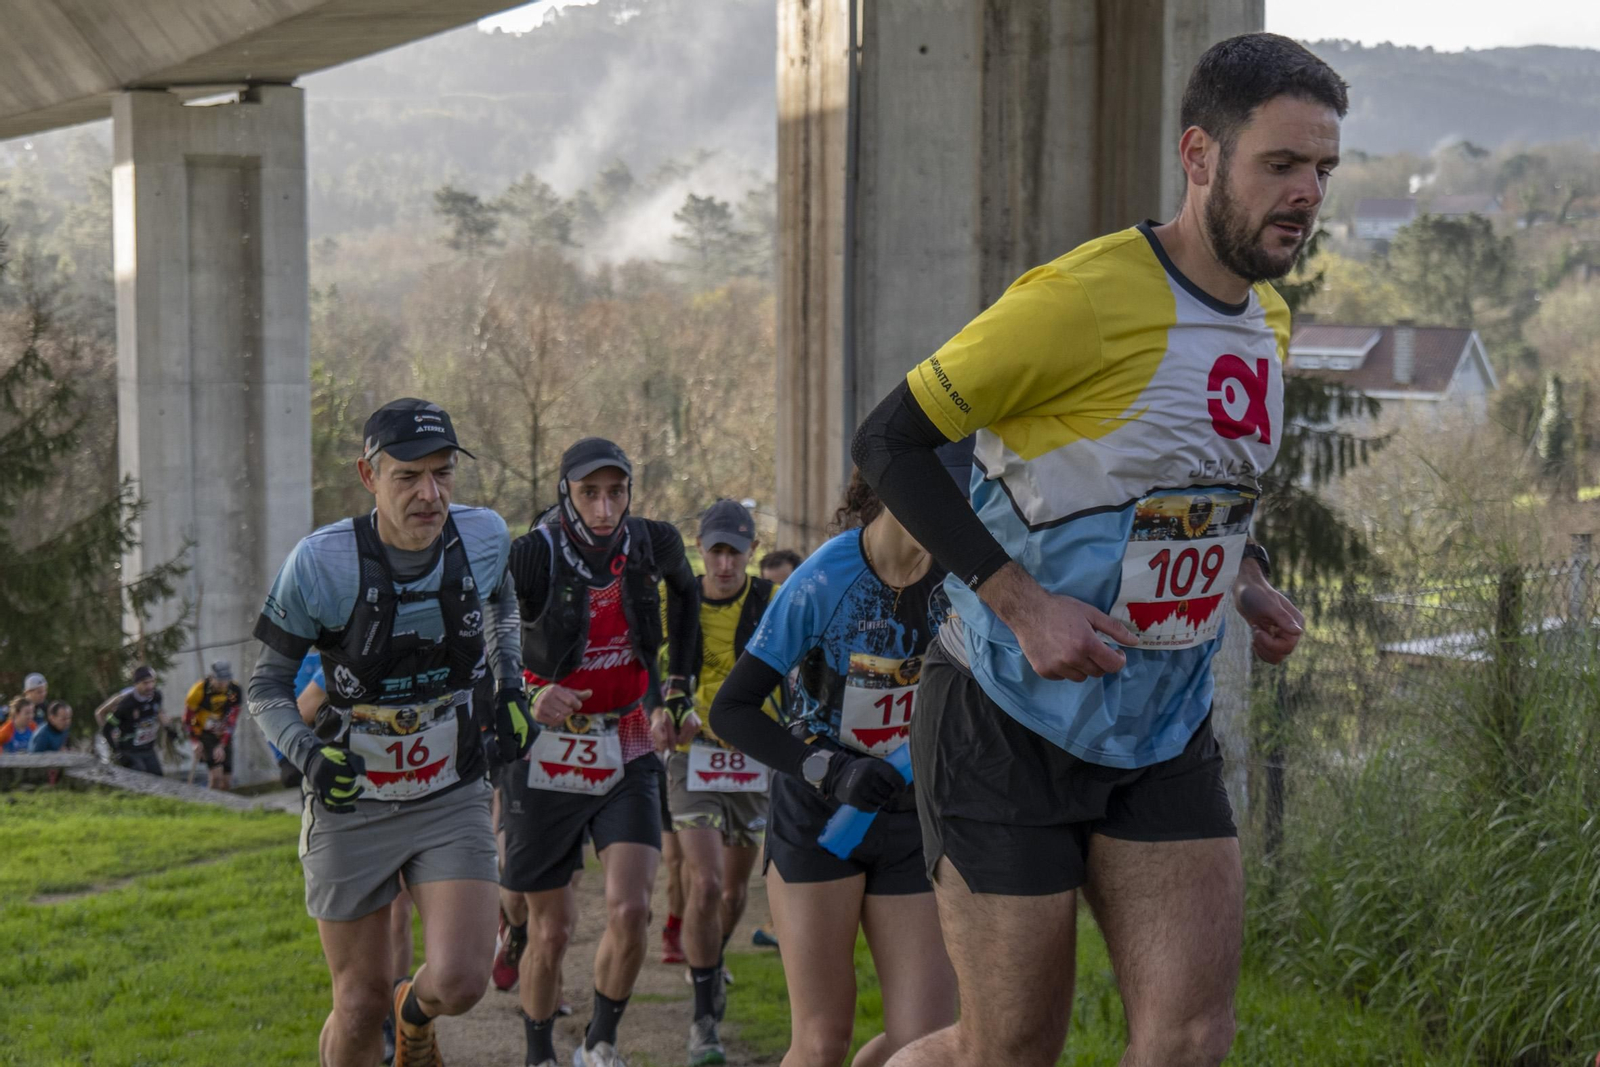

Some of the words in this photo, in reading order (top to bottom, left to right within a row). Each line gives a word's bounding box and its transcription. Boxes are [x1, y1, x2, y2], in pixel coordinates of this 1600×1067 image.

[1148, 544, 1225, 599] 109
[385, 736, 430, 770] 16
[559, 737, 598, 766] 73
[710, 752, 746, 771] 88
